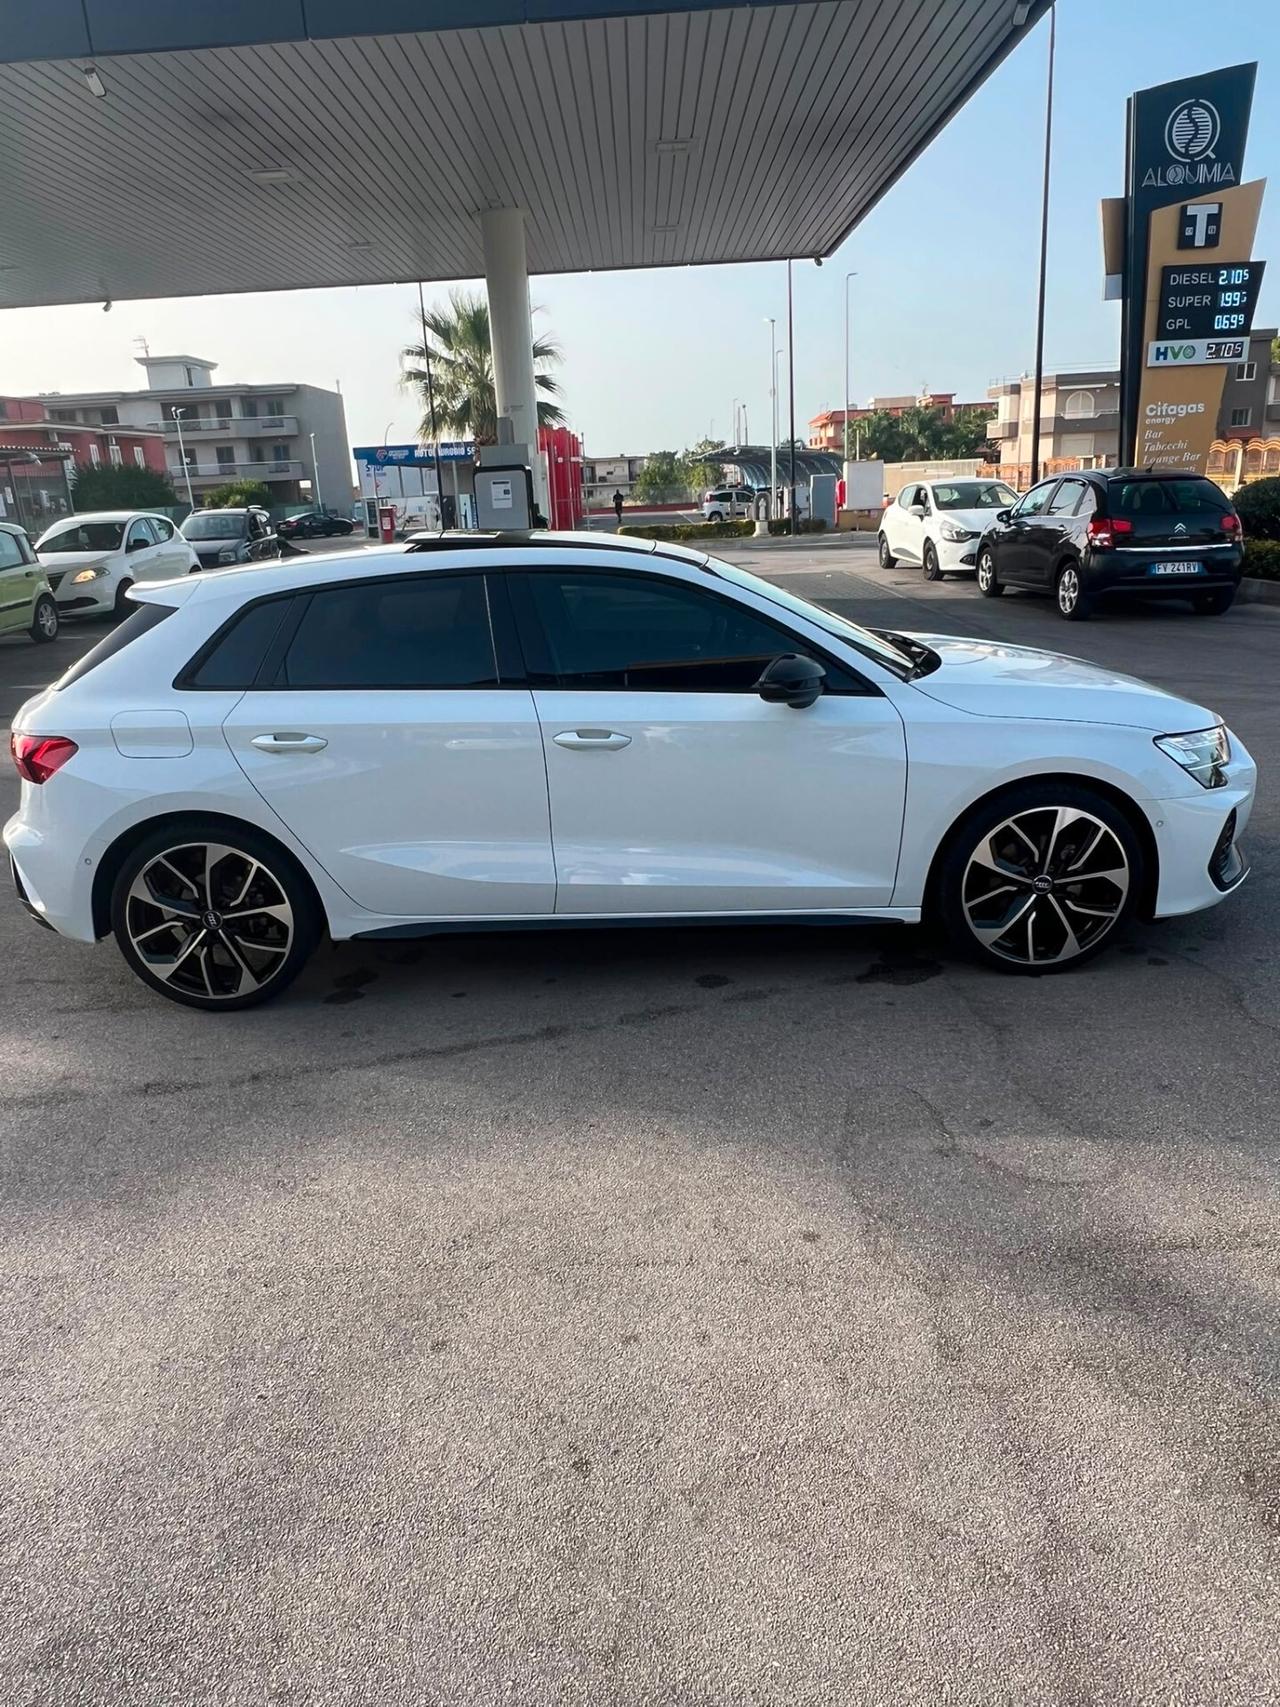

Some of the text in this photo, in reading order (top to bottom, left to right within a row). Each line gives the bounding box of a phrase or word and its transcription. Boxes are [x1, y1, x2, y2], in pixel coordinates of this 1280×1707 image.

[1142, 163, 1235, 188] ALQUIMIA
[1170, 273, 1214, 285] DIESEL
[1168, 295, 1211, 308] SUPER
[1166, 319, 1191, 330] GPL
[1155, 345, 1196, 361] HVO
[1146, 401, 1205, 416] Cifagas
[1145, 417, 1176, 425] energy
[1144, 430, 1163, 439] Bar
[1182, 452, 1201, 461] Bar
